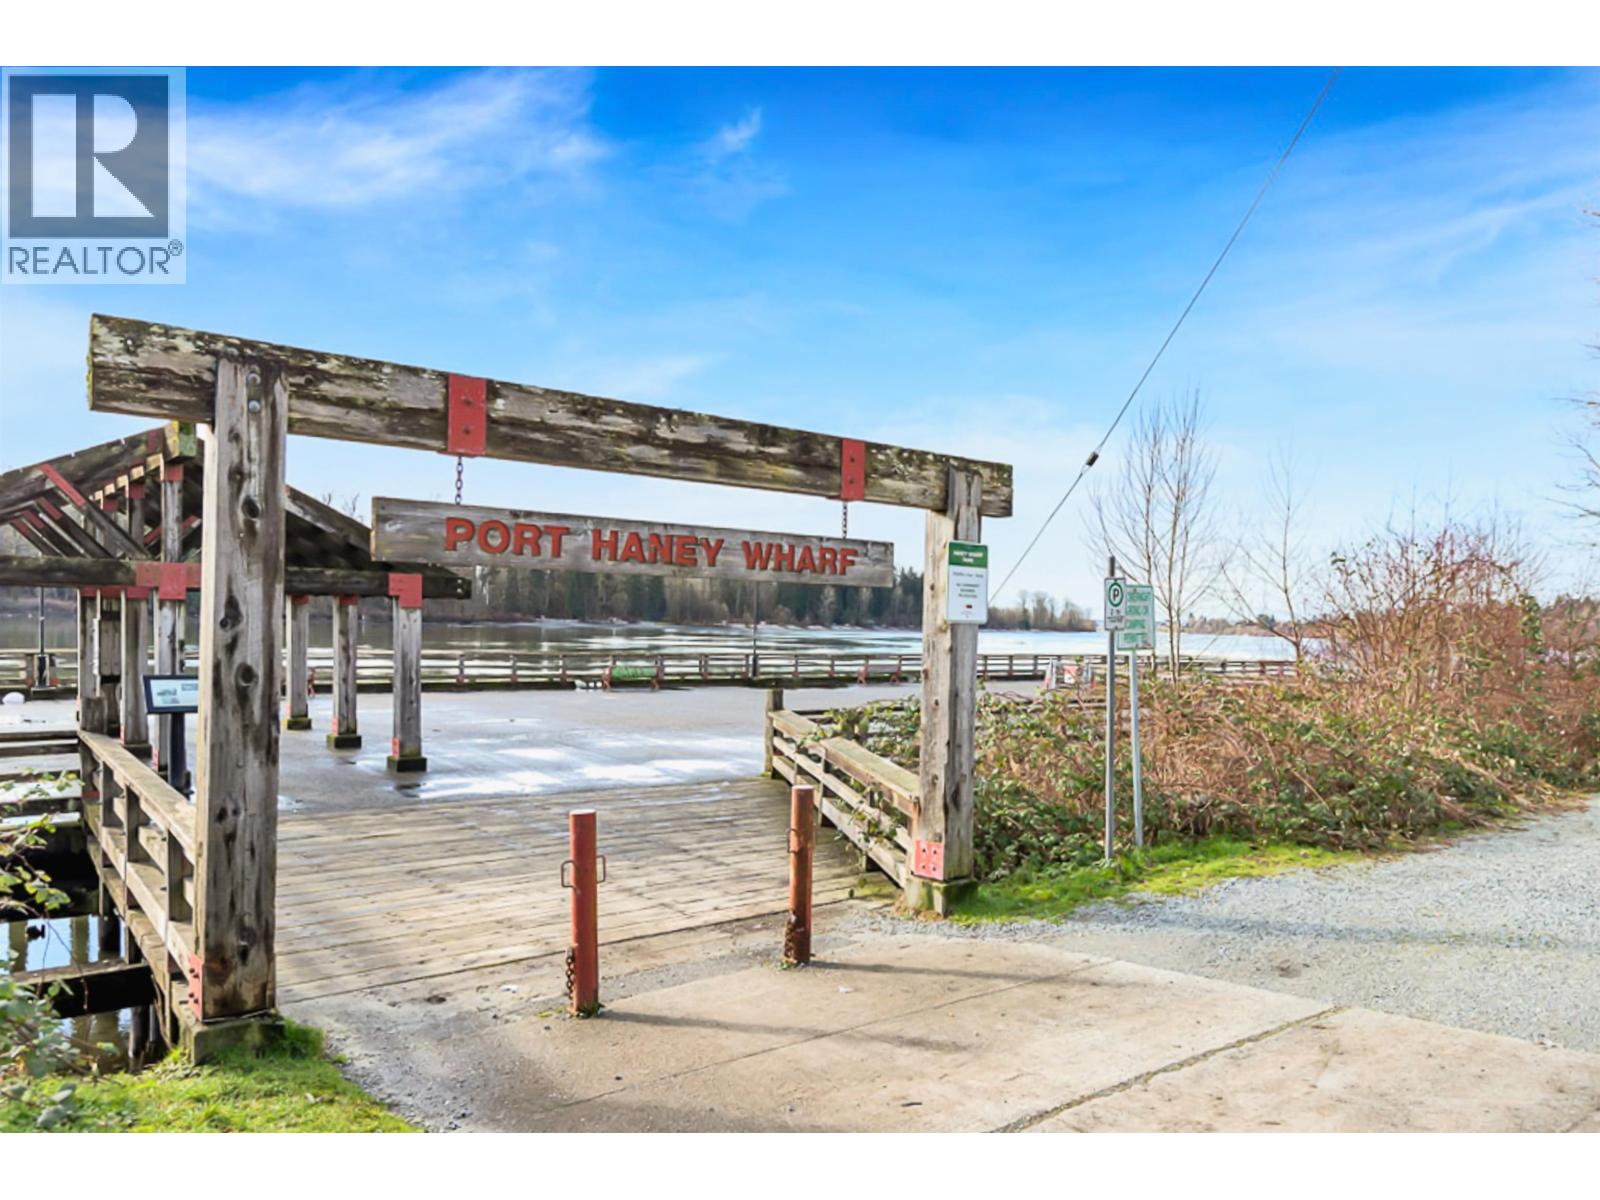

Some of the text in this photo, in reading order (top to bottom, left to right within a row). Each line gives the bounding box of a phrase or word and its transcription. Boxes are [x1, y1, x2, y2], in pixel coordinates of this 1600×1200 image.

[444, 517, 859, 576] PORT HANEY WHARF
